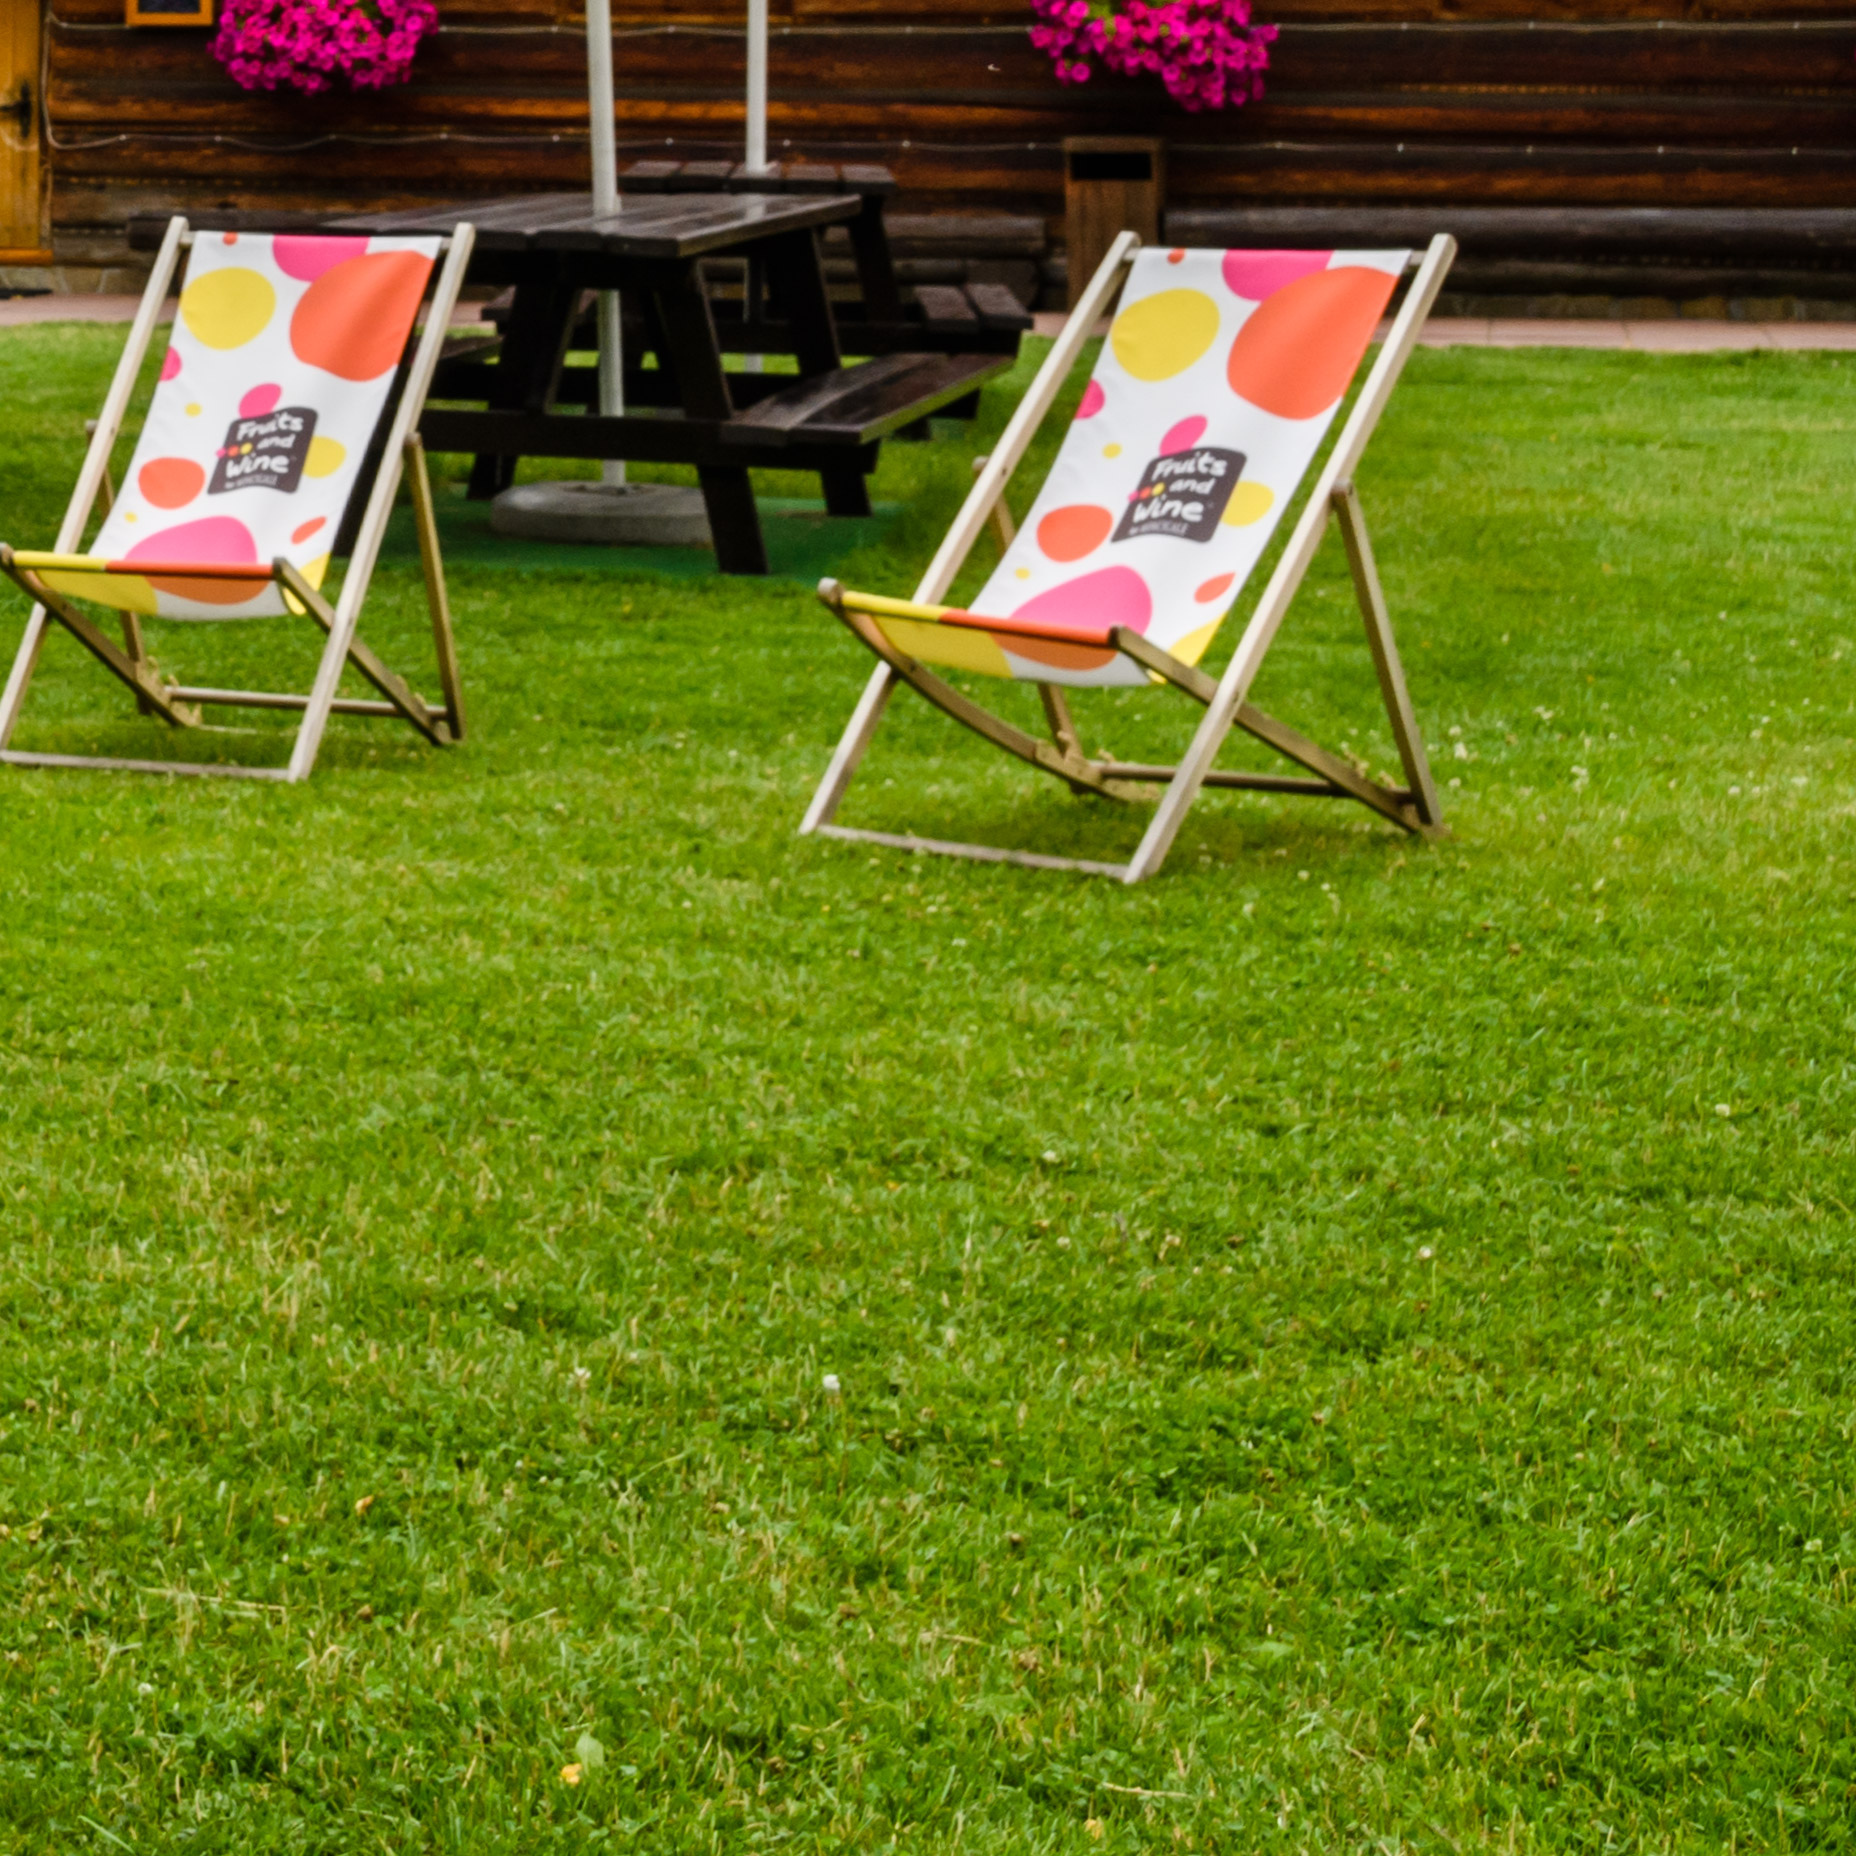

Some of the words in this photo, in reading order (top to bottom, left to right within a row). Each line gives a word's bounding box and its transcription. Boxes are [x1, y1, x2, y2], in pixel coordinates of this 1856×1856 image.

[236, 411, 304, 442] Fruits
[256, 433, 296, 450] and
[225, 452, 290, 478] Wine
[1151, 451, 1227, 482] Fruits
[1169, 477, 1216, 494] and
[1133, 494, 1205, 524] Wine
